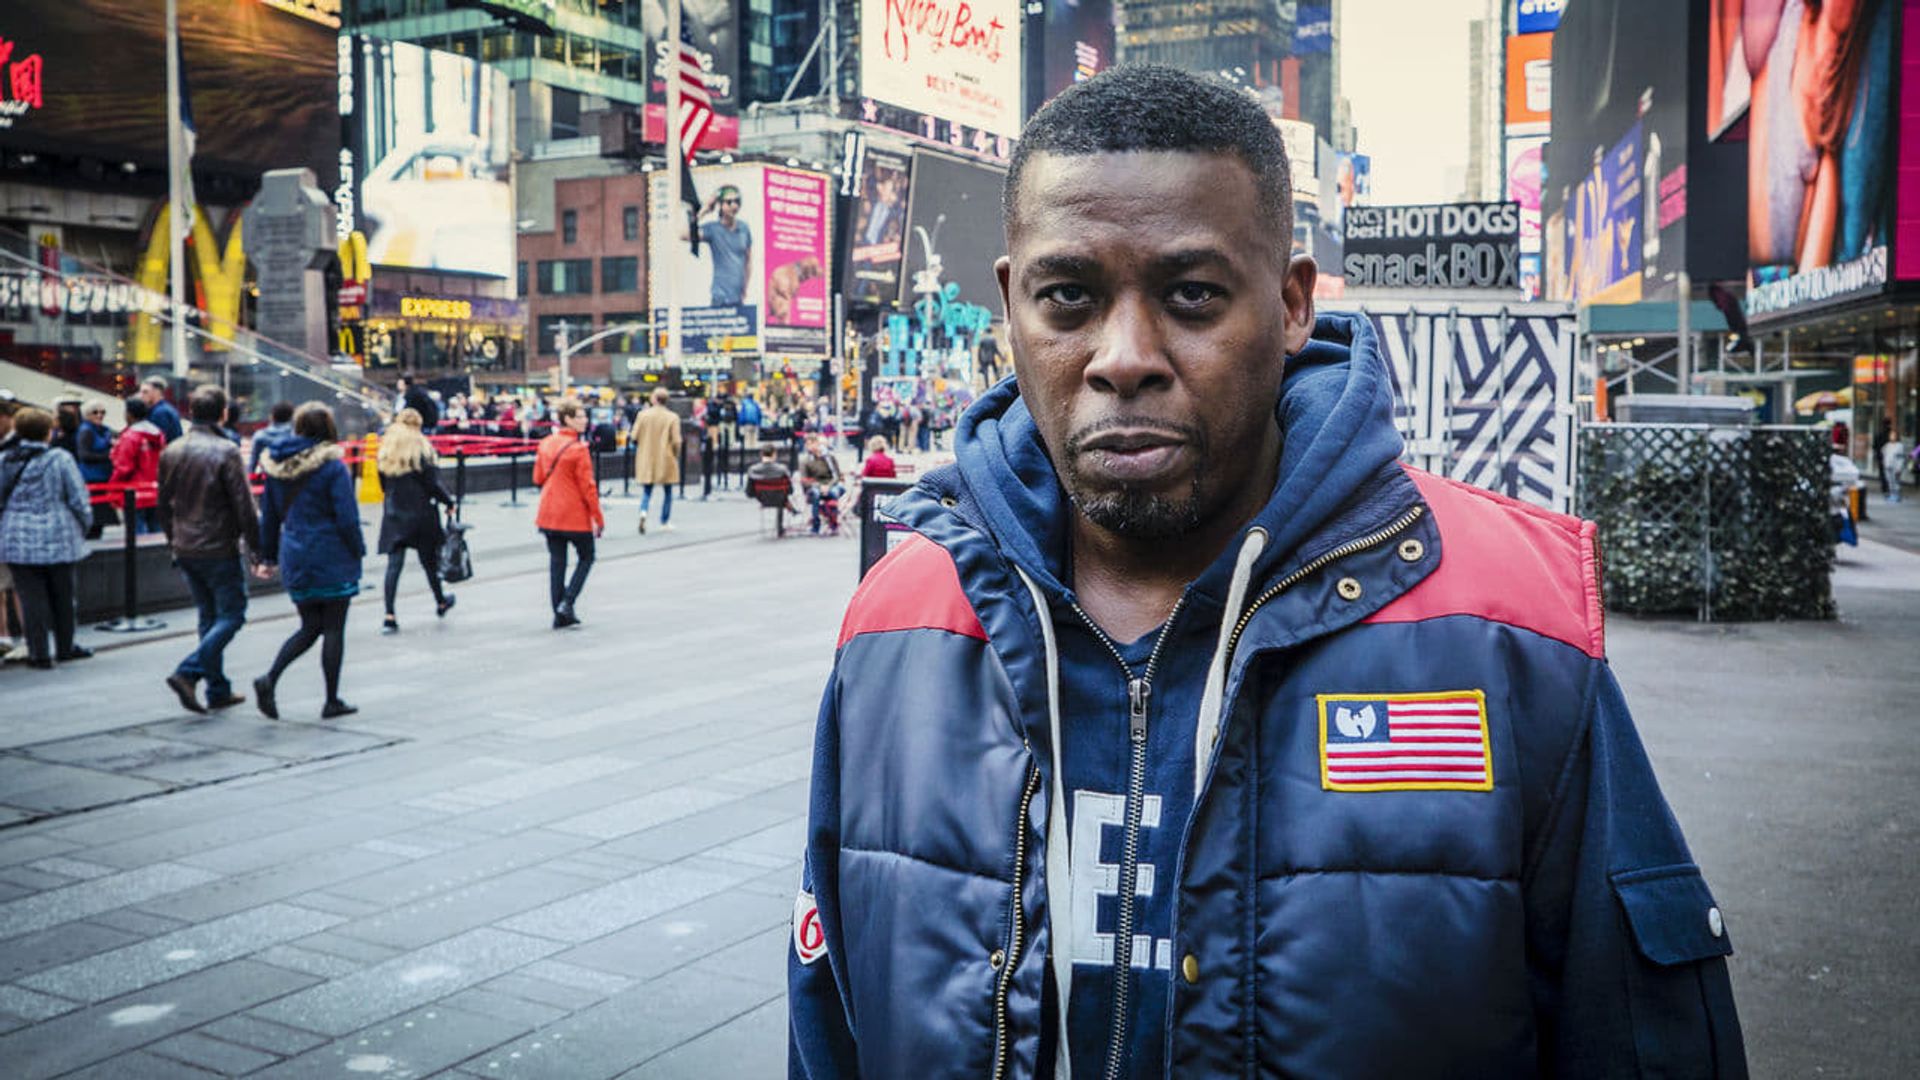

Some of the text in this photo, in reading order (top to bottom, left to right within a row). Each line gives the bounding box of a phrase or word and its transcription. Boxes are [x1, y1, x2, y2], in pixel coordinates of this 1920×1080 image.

[1346, 223, 1383, 239] best
[1385, 204, 1518, 238] HOT DOGS
